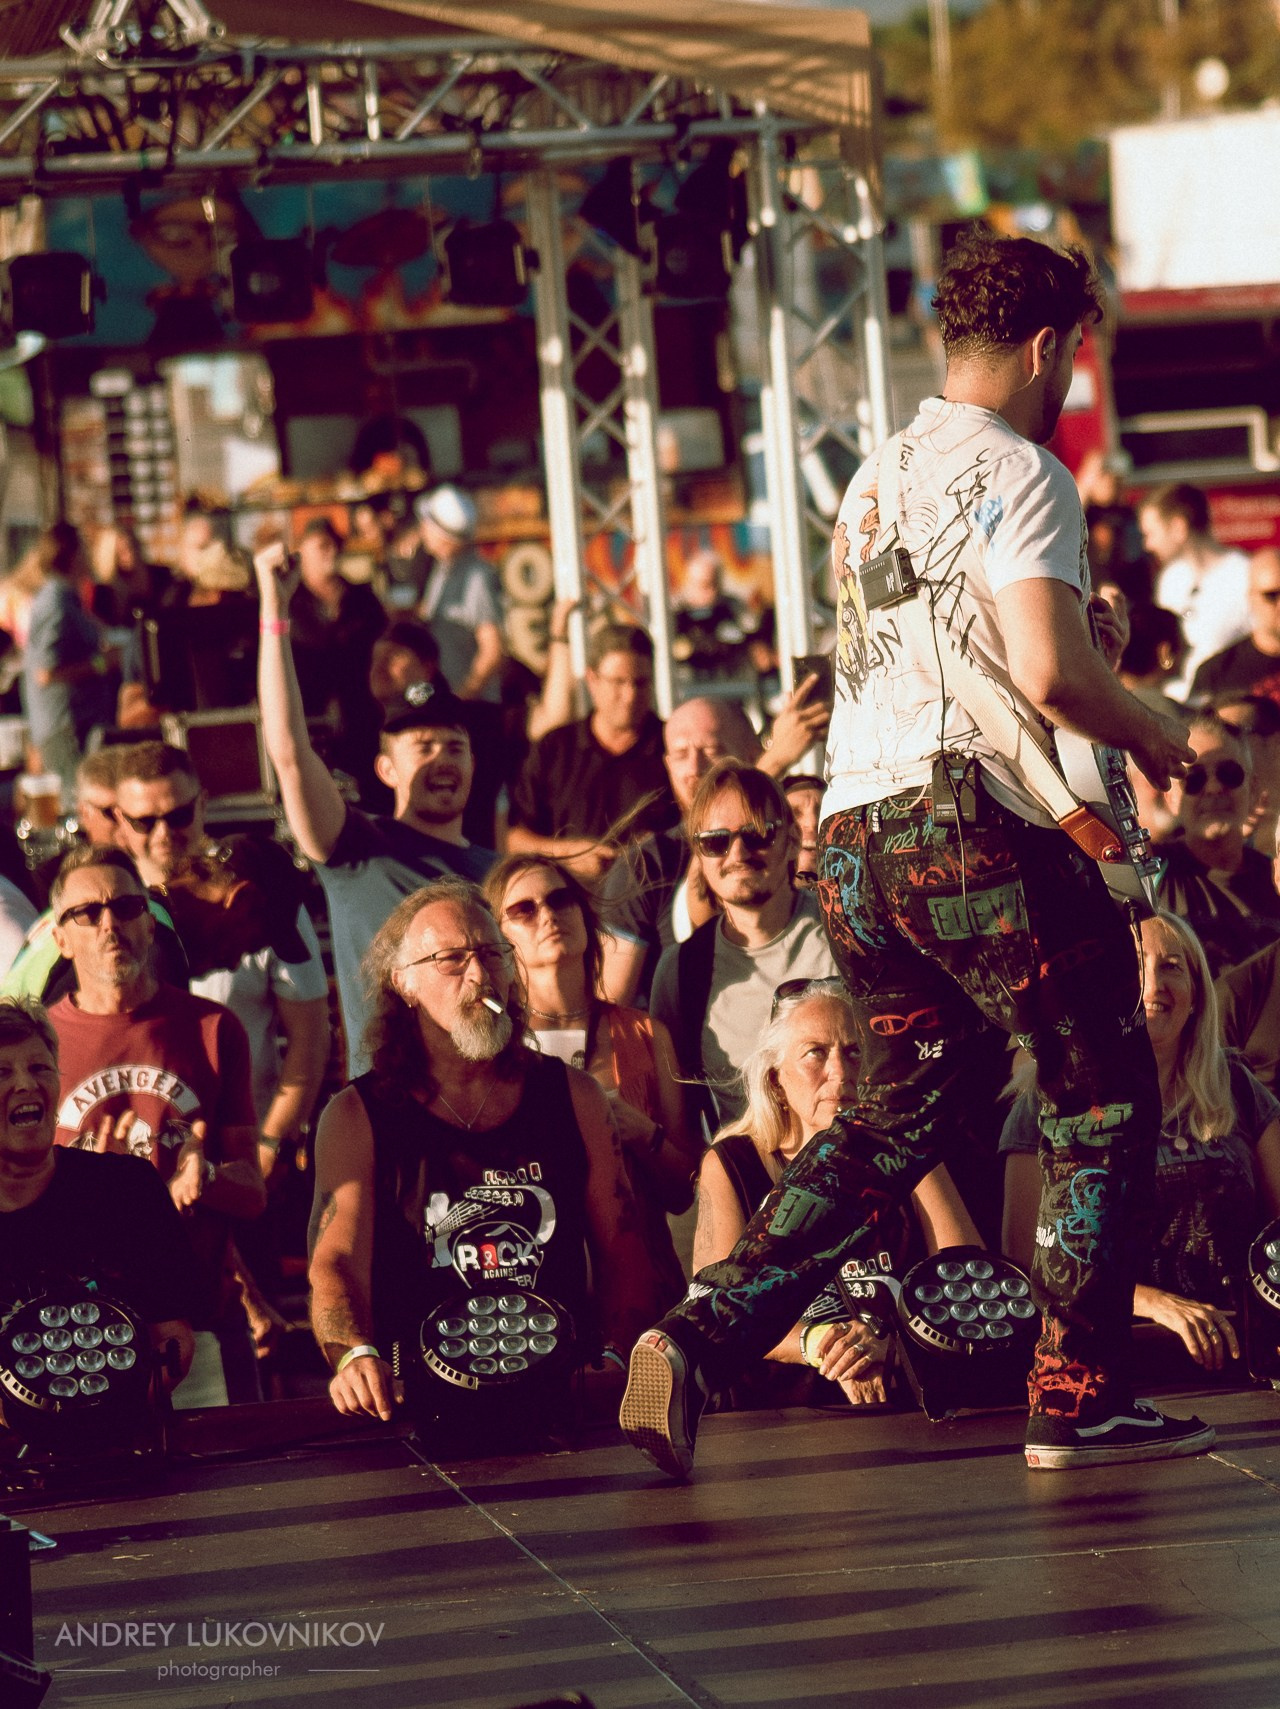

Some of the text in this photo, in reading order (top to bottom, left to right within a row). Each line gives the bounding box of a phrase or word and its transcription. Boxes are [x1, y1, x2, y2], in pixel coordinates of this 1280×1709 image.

[72, 1069, 185, 1113] AVENGED
[457, 1240, 540, 1272] ROCK
[484, 1267, 518, 1279] AGAINST
